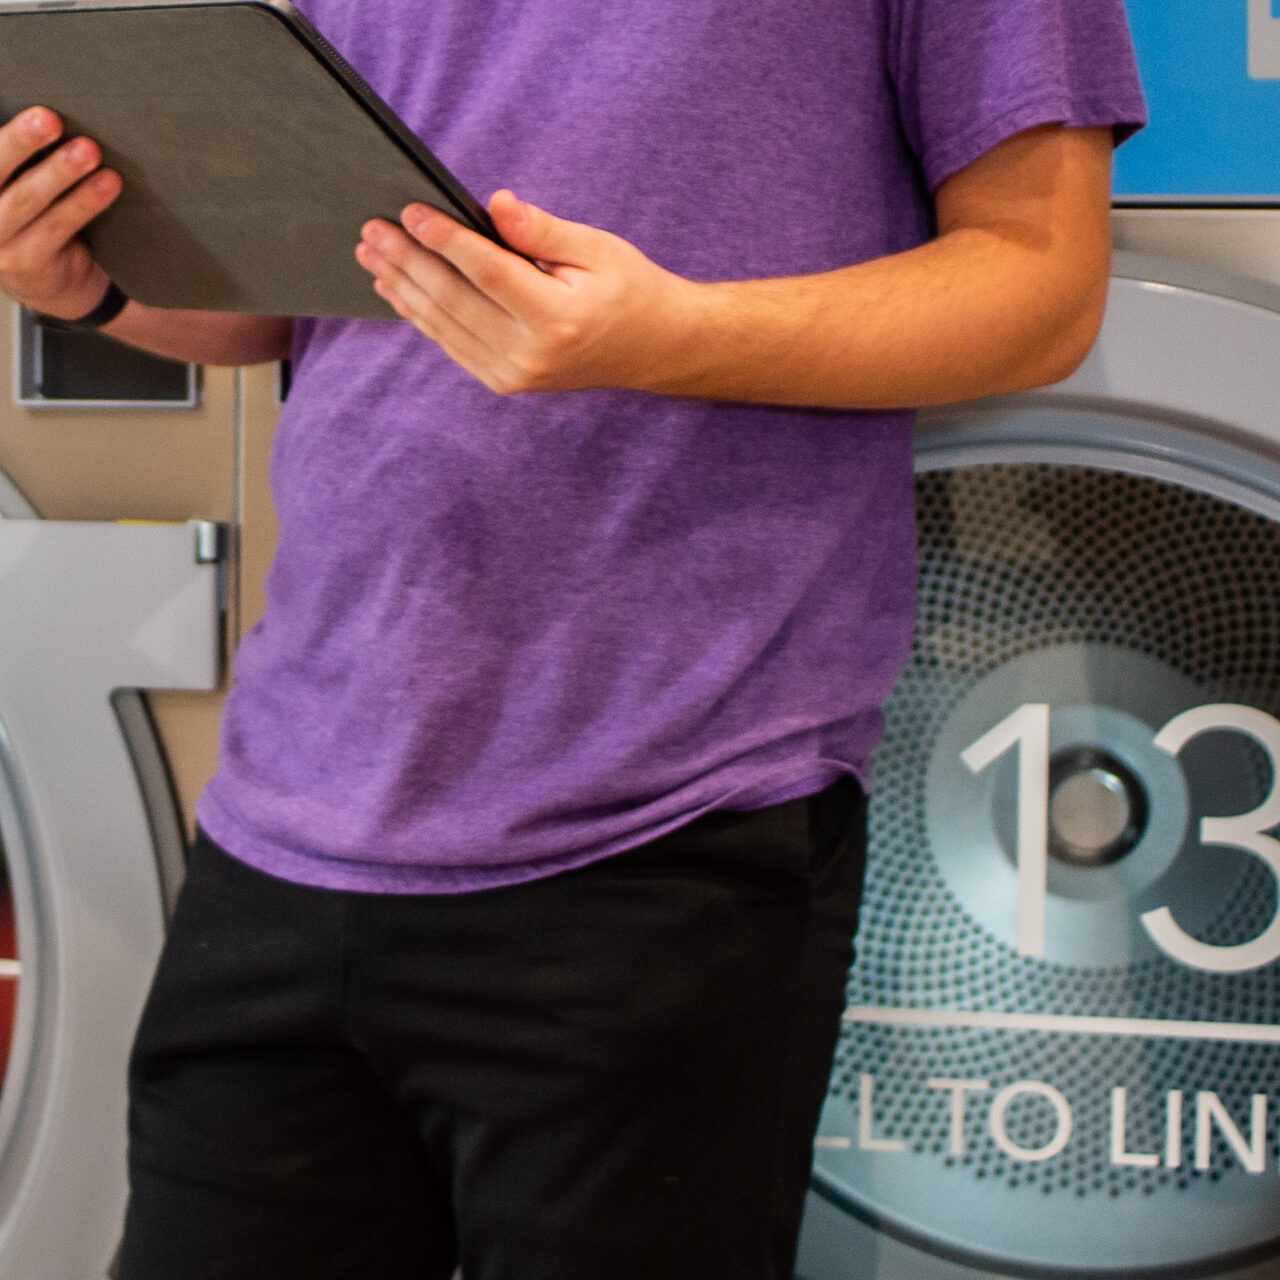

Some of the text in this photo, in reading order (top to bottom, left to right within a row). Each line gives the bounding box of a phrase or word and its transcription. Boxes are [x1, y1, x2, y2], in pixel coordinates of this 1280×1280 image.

[960, 702, 1280, 974] 13
[927, 1077, 1073, 1162] TO
[1111, 1085, 1280, 1174] LIN
